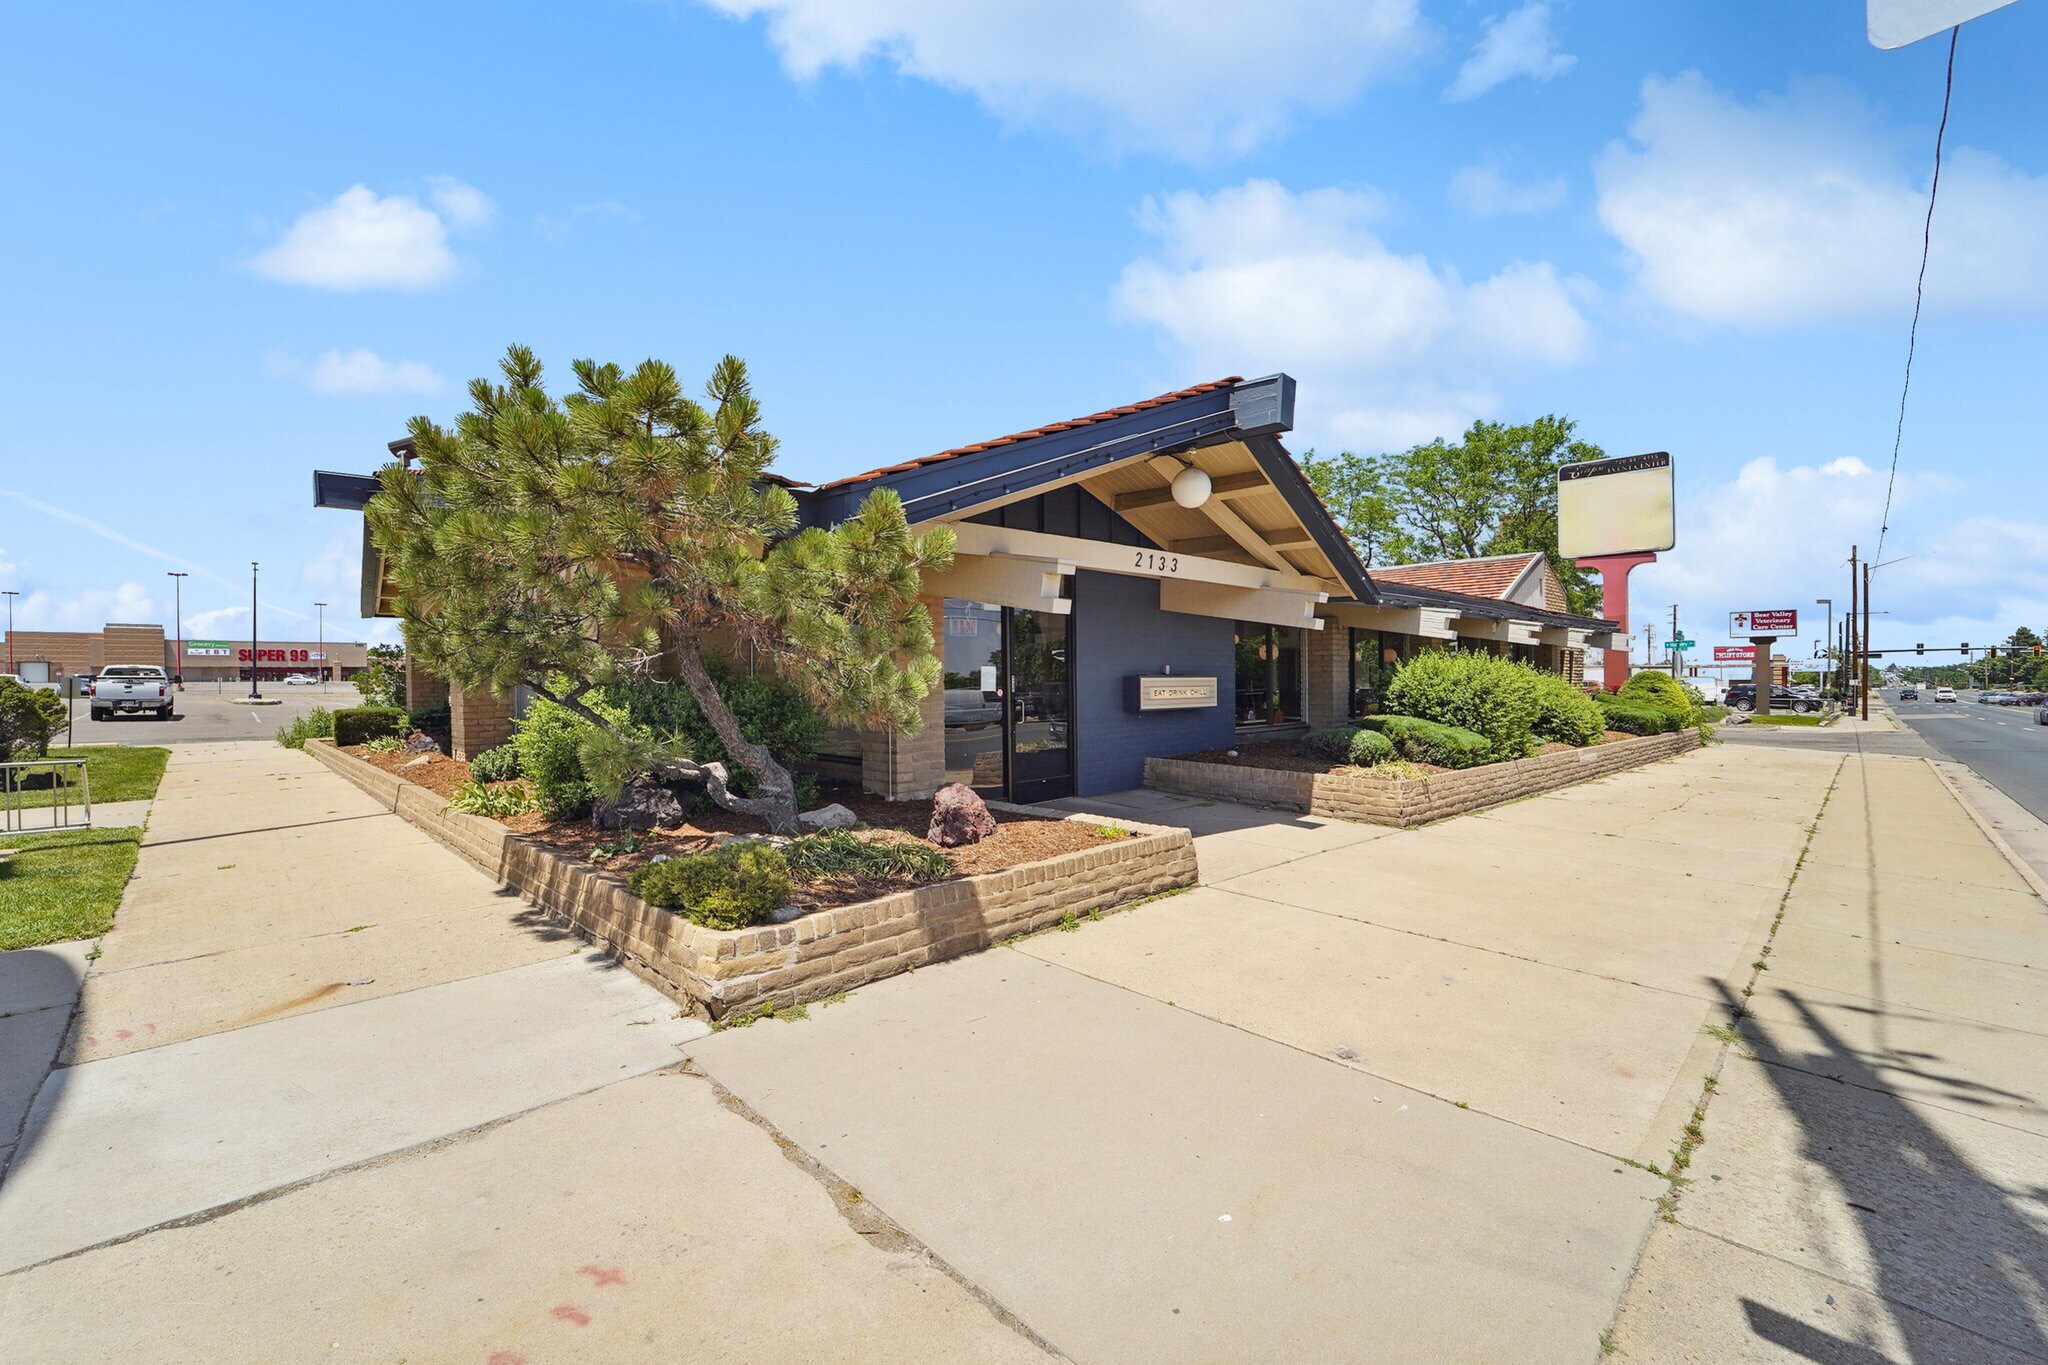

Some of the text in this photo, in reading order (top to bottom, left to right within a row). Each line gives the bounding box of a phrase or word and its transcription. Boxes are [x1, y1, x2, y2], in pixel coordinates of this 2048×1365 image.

[1135, 552, 1178, 572] 2133
[188, 640, 215, 648] Grocery
[238, 648, 287, 662] SUPER
[289, 649, 309, 662] 99
[1153, 689, 1166, 697] EAT
[1168, 689, 1188, 697] DRINK
